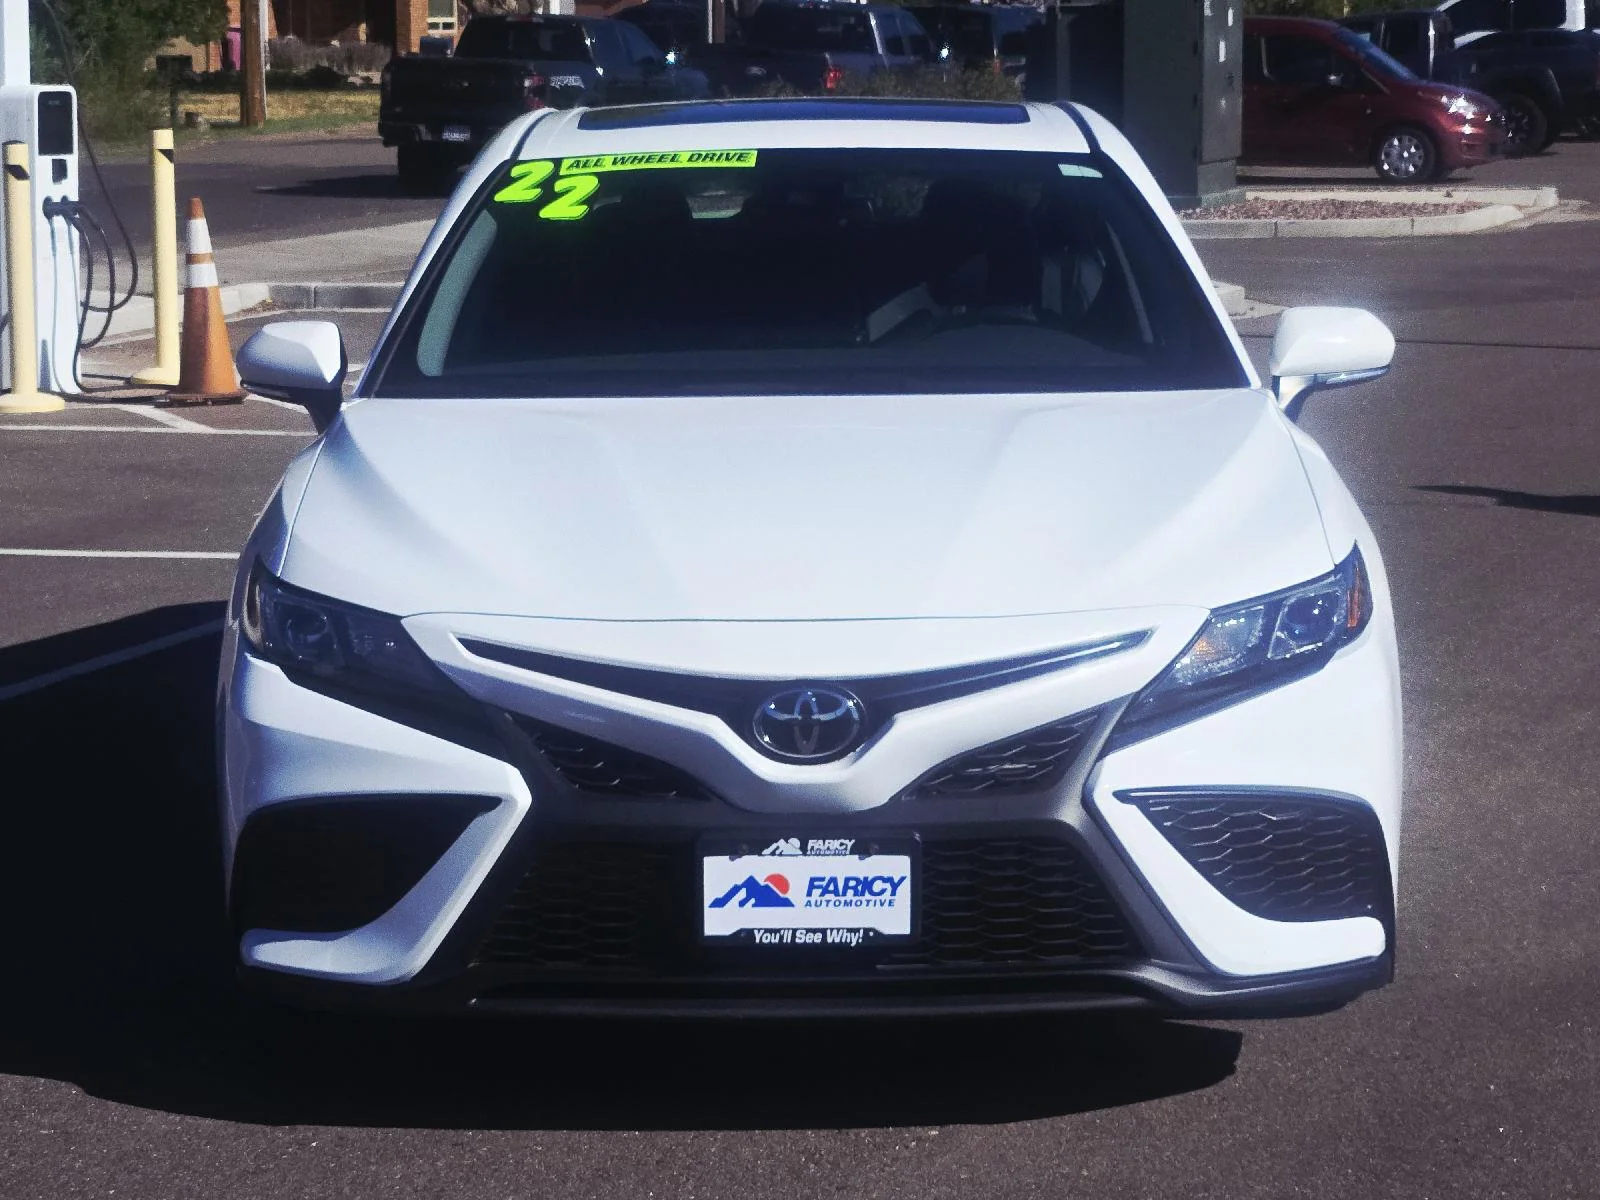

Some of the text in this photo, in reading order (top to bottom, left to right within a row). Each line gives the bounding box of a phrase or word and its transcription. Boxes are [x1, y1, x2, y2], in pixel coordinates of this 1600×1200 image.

[567, 151, 750, 170] ALL WHEEL DRIVE
[806, 839, 855, 851] FARICY
[806, 875, 907, 897] FARICY
[804, 899, 895, 907] AUTOMOTIVE
[753, 929, 863, 946] You'll See Why!
